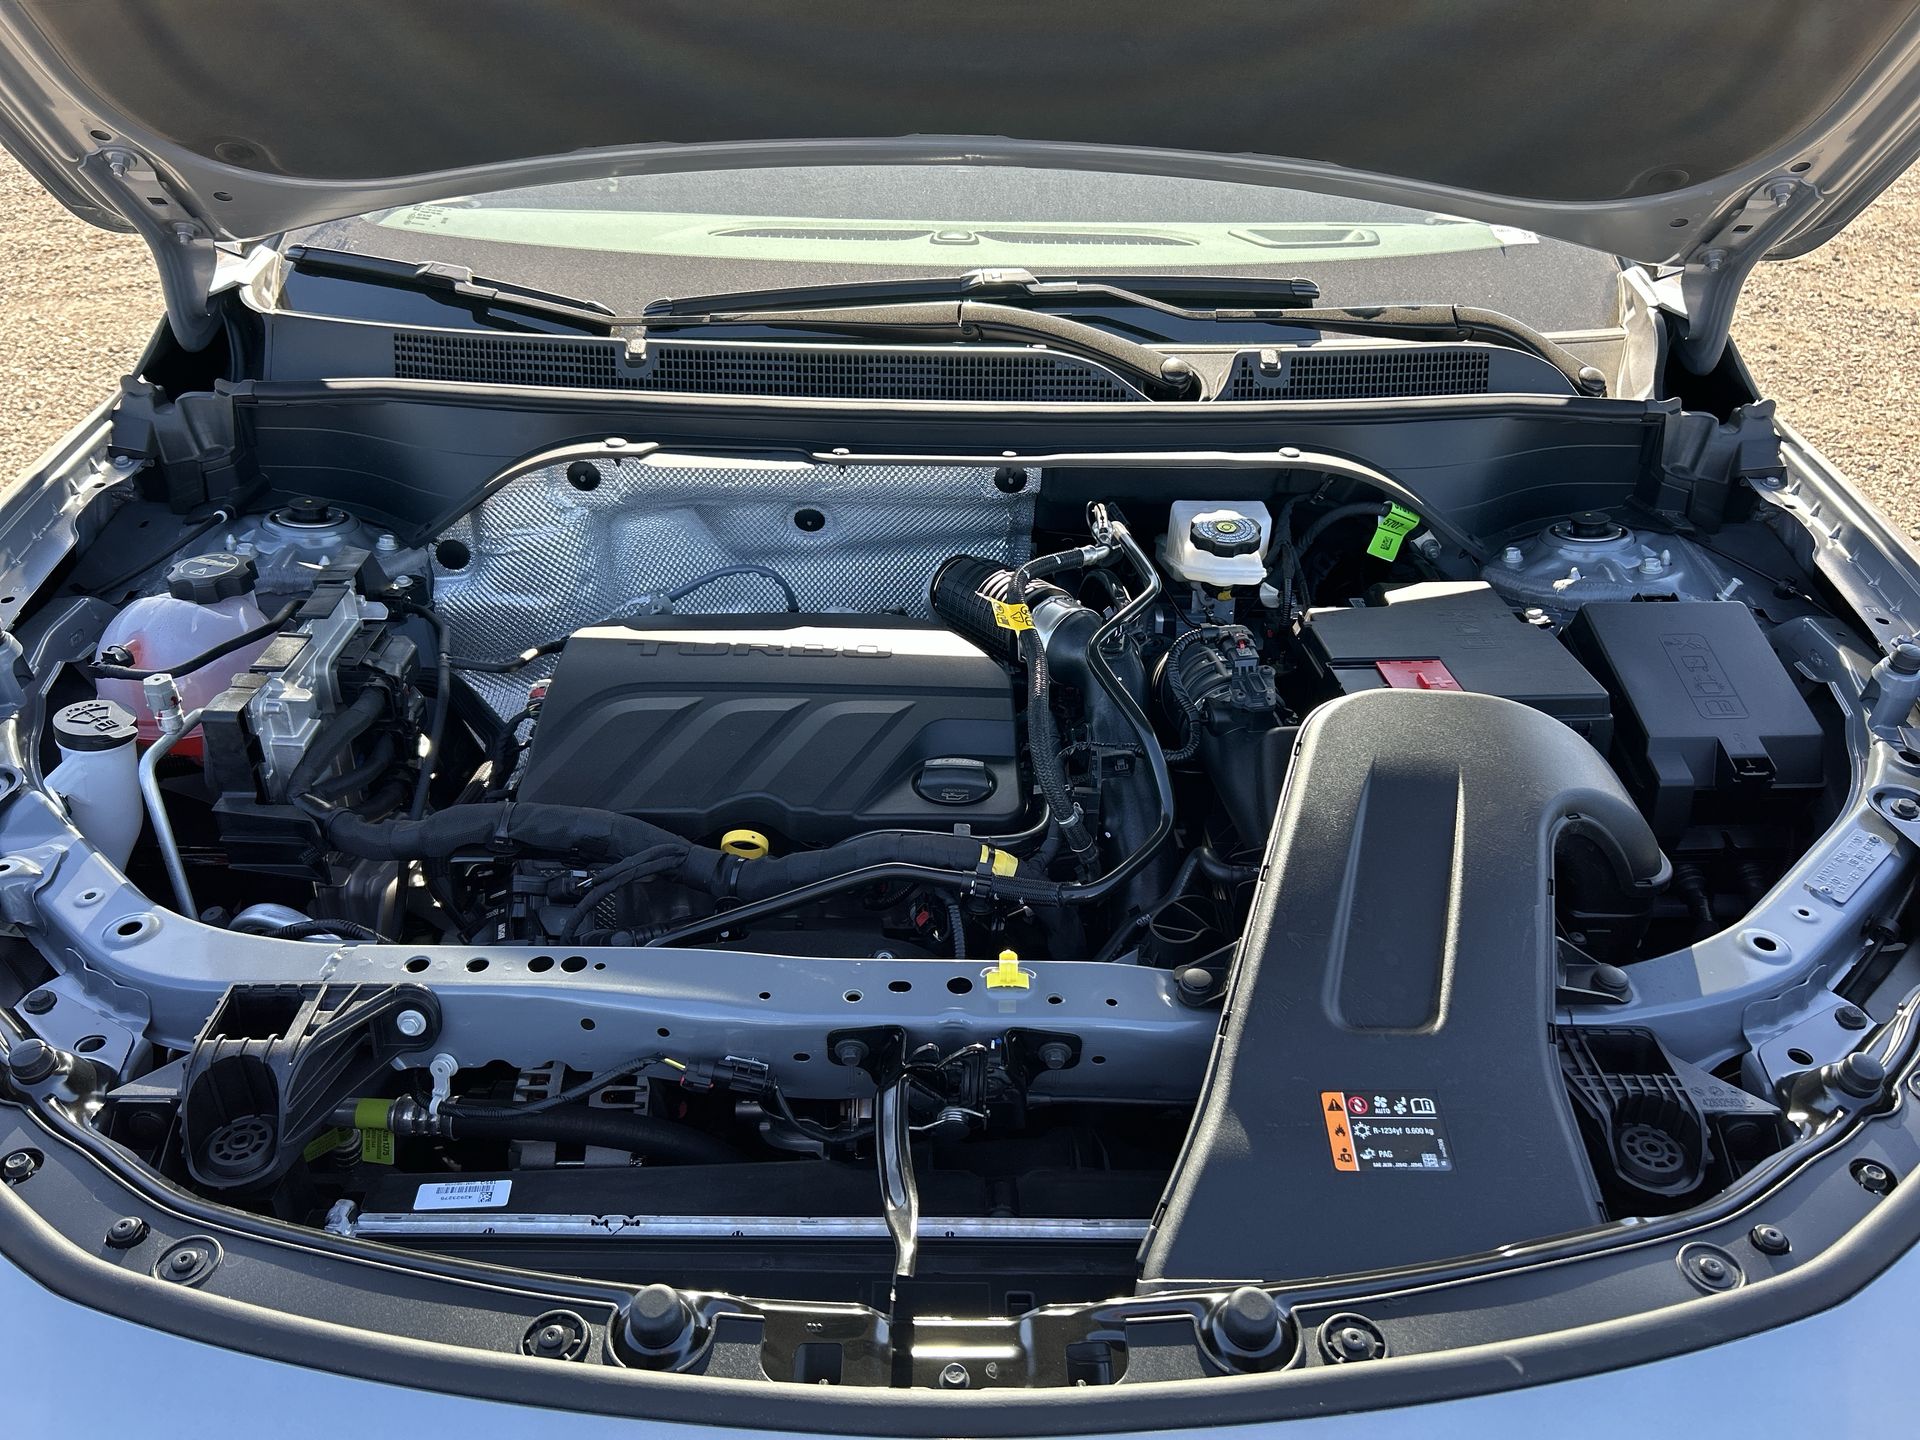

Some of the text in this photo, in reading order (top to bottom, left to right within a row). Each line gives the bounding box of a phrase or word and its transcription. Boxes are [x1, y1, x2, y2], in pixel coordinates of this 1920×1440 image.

[627, 641, 892, 659] TURBO
[1373, 1127, 1434, 1136] R-1234yf 0.600 kg
[1378, 1150, 1393, 1158] PAG
